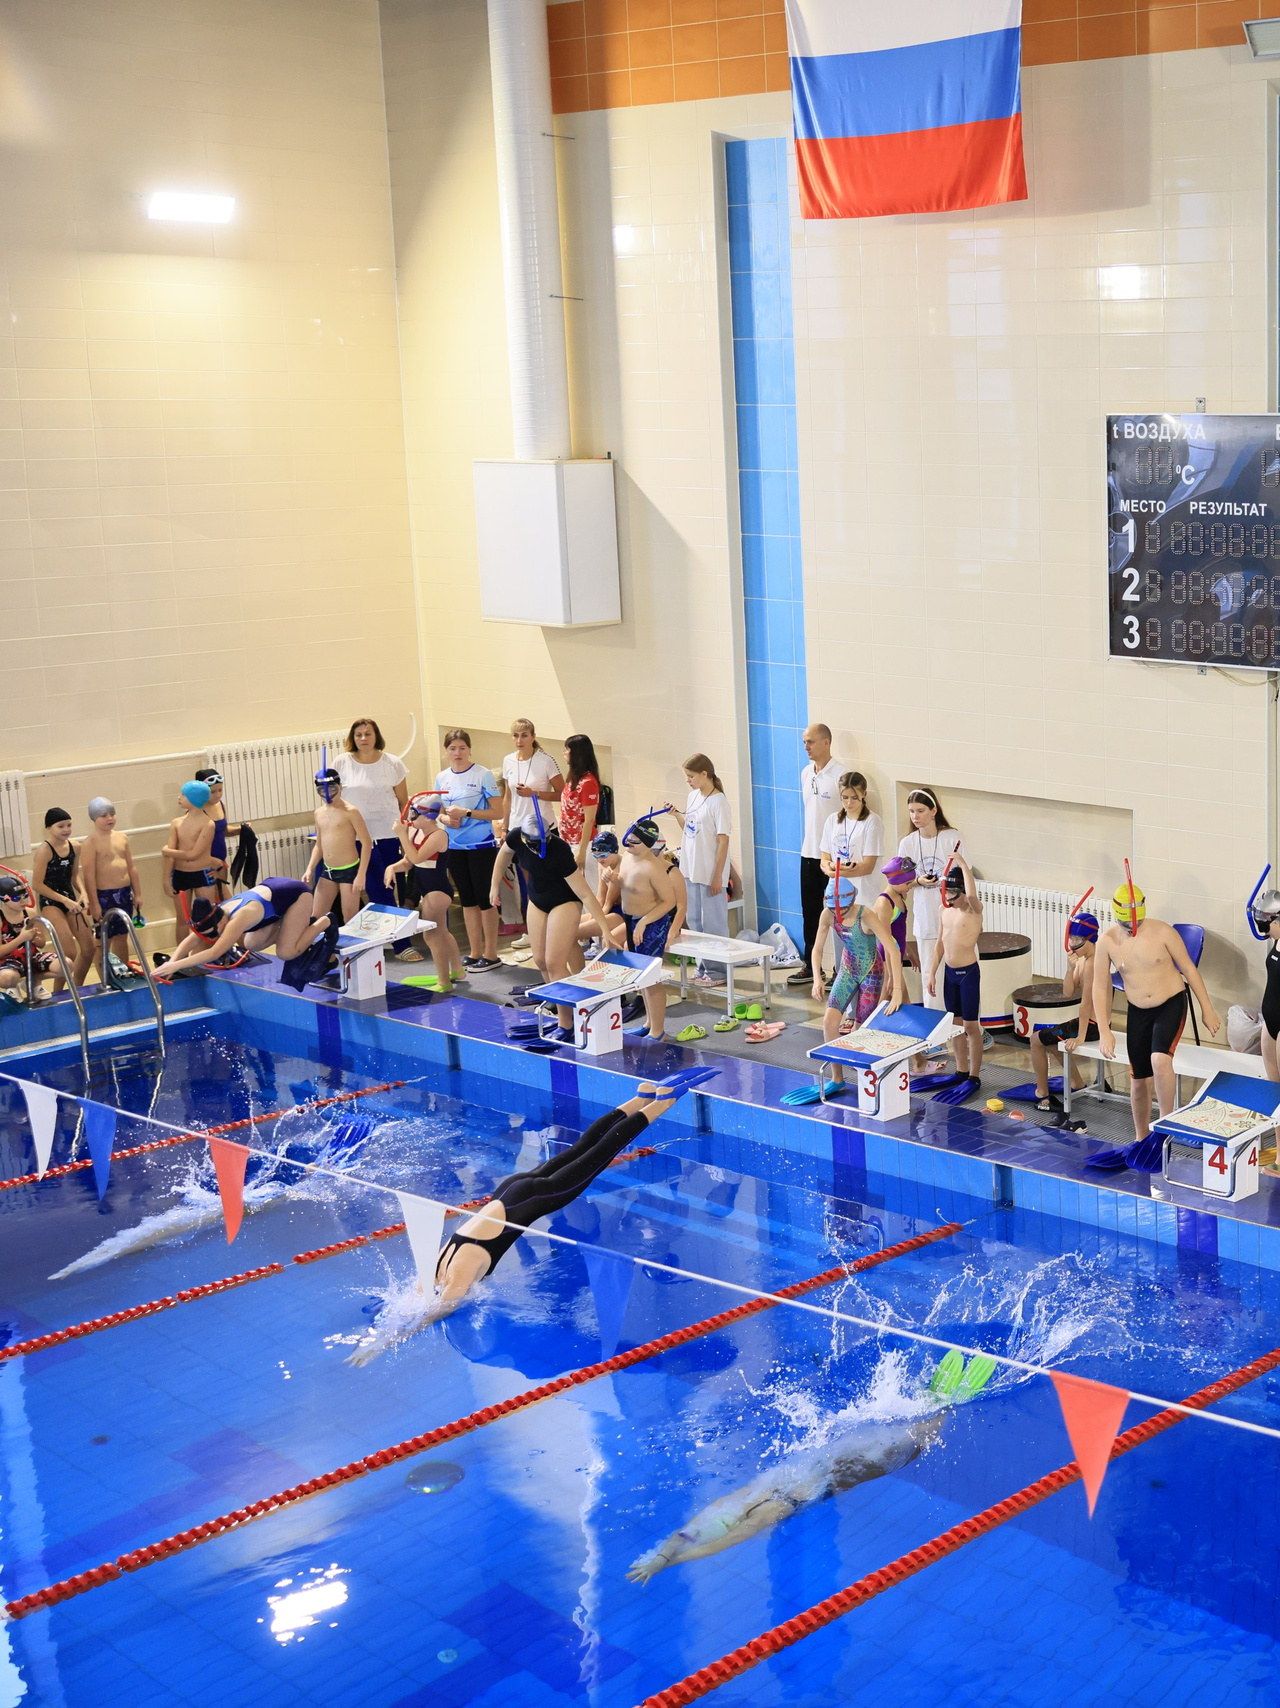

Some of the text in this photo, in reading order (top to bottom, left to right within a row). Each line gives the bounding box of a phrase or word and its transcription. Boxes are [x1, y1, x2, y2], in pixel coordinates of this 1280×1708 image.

[1113, 423, 1206, 443] t ВОЗДУХА
[1120, 500, 1267, 516] МЕСТО РЕЗУЛЬТАТ
[1122, 519, 1135, 552] 1
[1122, 568, 1140, 601] 2
[1123, 615, 1140, 649] 3
[375, 961, 382, 976] 1
[610, 1013, 621, 1030] 2
[1017, 1006, 1029, 1037] 3
[864, 1070, 878, 1097] 3
[899, 1072, 908, 1091] 3
[1208, 1146, 1228, 1175] 4
[1248, 1147, 1257, 1166] 4
